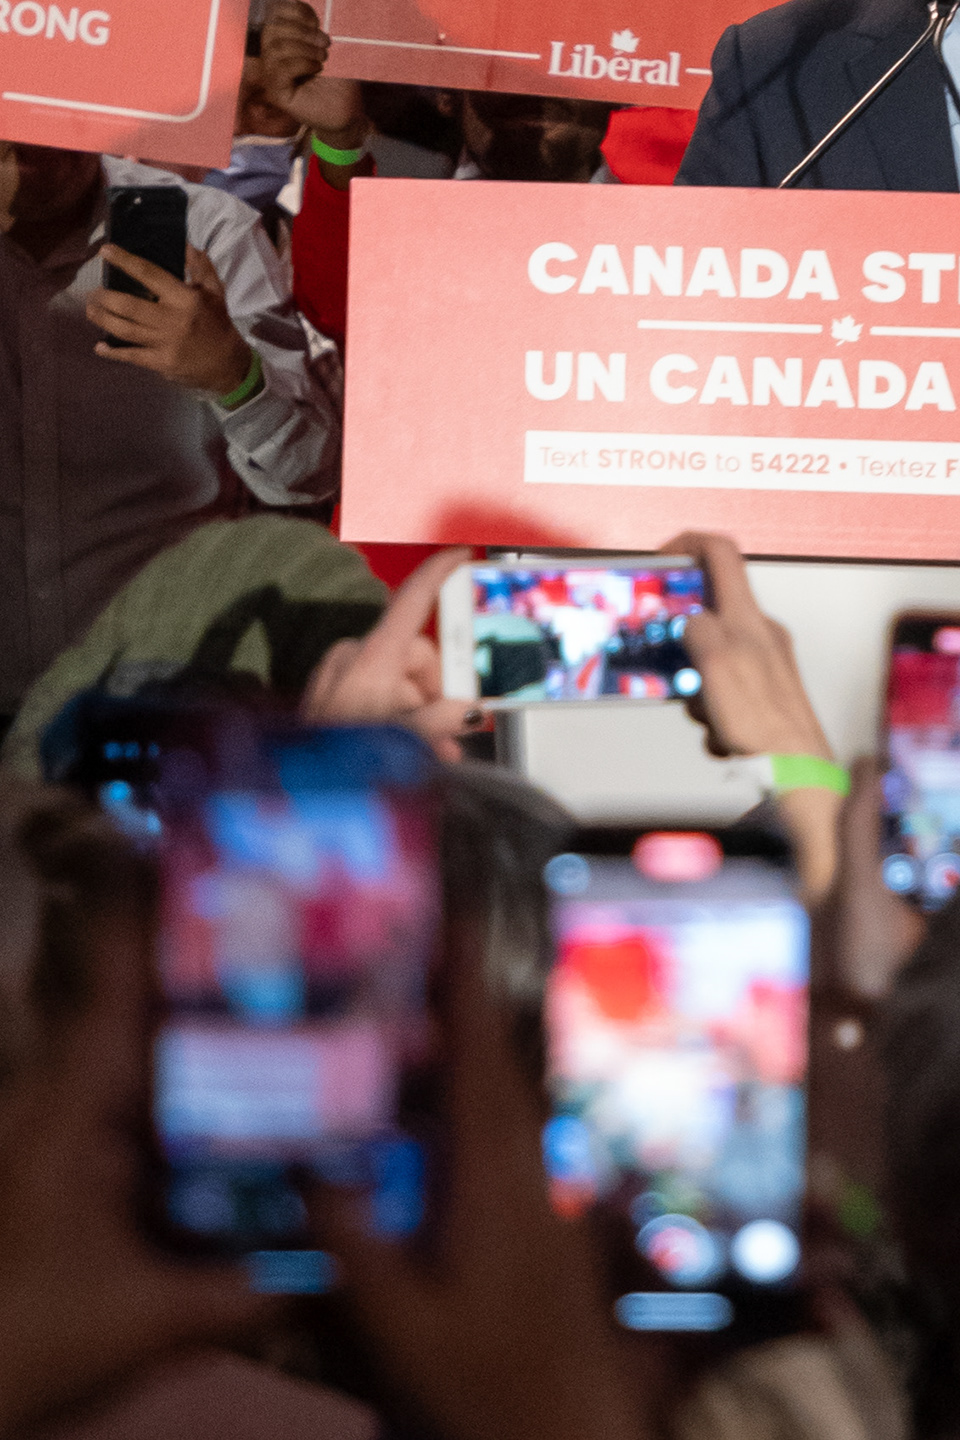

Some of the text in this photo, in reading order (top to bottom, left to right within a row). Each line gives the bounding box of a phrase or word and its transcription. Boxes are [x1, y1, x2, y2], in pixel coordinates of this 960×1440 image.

[527, 242, 840, 301] CANADA
[524, 350, 626, 402] UN
[649, 353, 957, 412] CANADA
[540, 446, 589, 468] Text
[597, 448, 707, 471] STRONG
[715, 452, 741, 472] to
[751, 452, 830, 474] 54222
[857, 455, 936, 479] Textez
